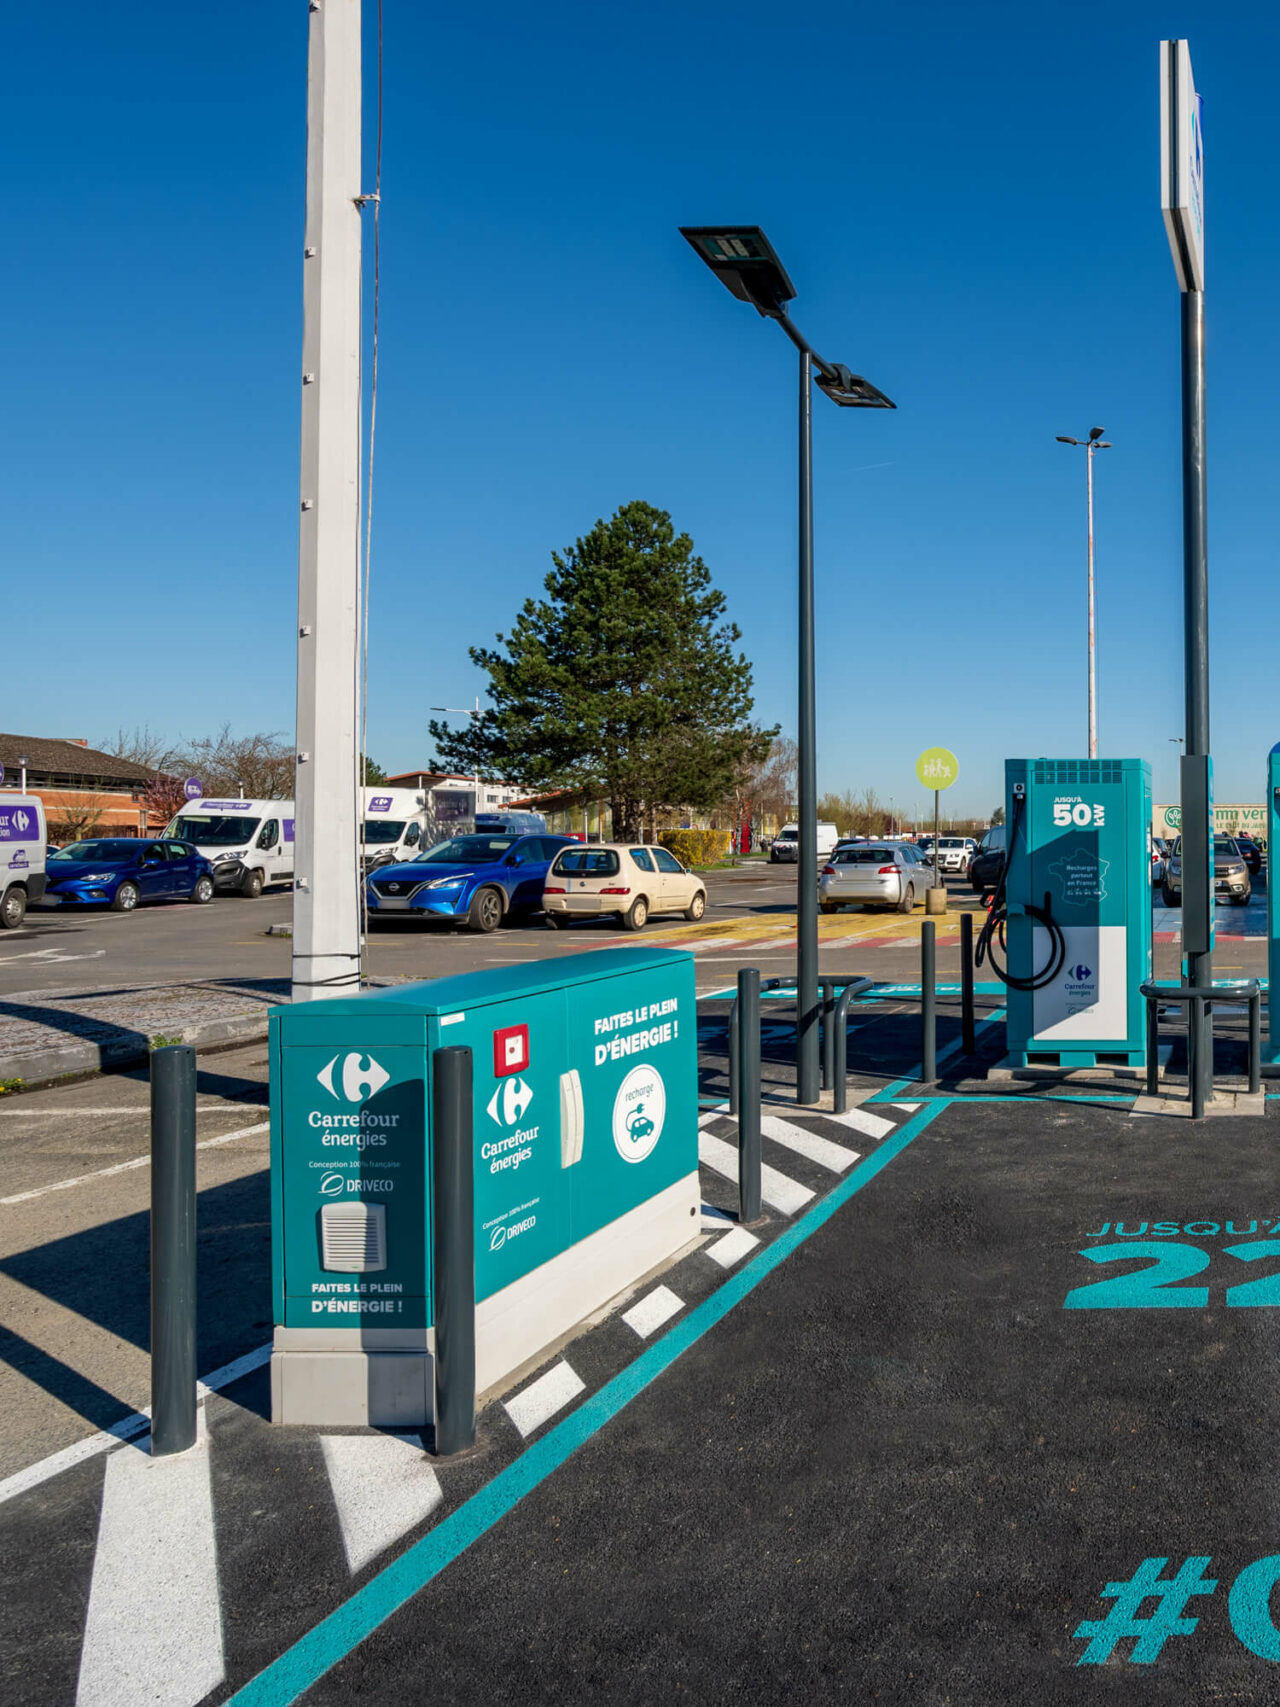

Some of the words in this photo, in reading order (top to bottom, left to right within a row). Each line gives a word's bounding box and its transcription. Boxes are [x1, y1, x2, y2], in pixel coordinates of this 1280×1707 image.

[1053, 803, 1092, 826] 50
[1093, 803, 1105, 826] kW
[1242, 809, 1267, 820] ver
[594, 1011, 633, 1035] FAITES
[635, 1006, 648, 1023] LE
[649, 997, 678, 1019] PLEIN
[594, 1022, 672, 1066] D'ÉNERGIE
[625, 1083, 654, 1103] recharge
[308, 1110, 400, 1127] Carrefour
[321, 1129, 388, 1151] énergies
[481, 1126, 540, 1159] Carrefour
[308, 1161, 348, 1169] Conception
[490, 1147, 532, 1174] énergies
[346, 1179, 394, 1192] DRIVECO
[482, 1212, 508, 1230] Conception
[507, 1215, 537, 1240] DRIVECO
[311, 1283, 352, 1293] FAITES
[353, 1283, 367, 1293] LE
[369, 1283, 403, 1293] PLEIN
[311, 1296, 394, 1313] D'ÉNERGIE
